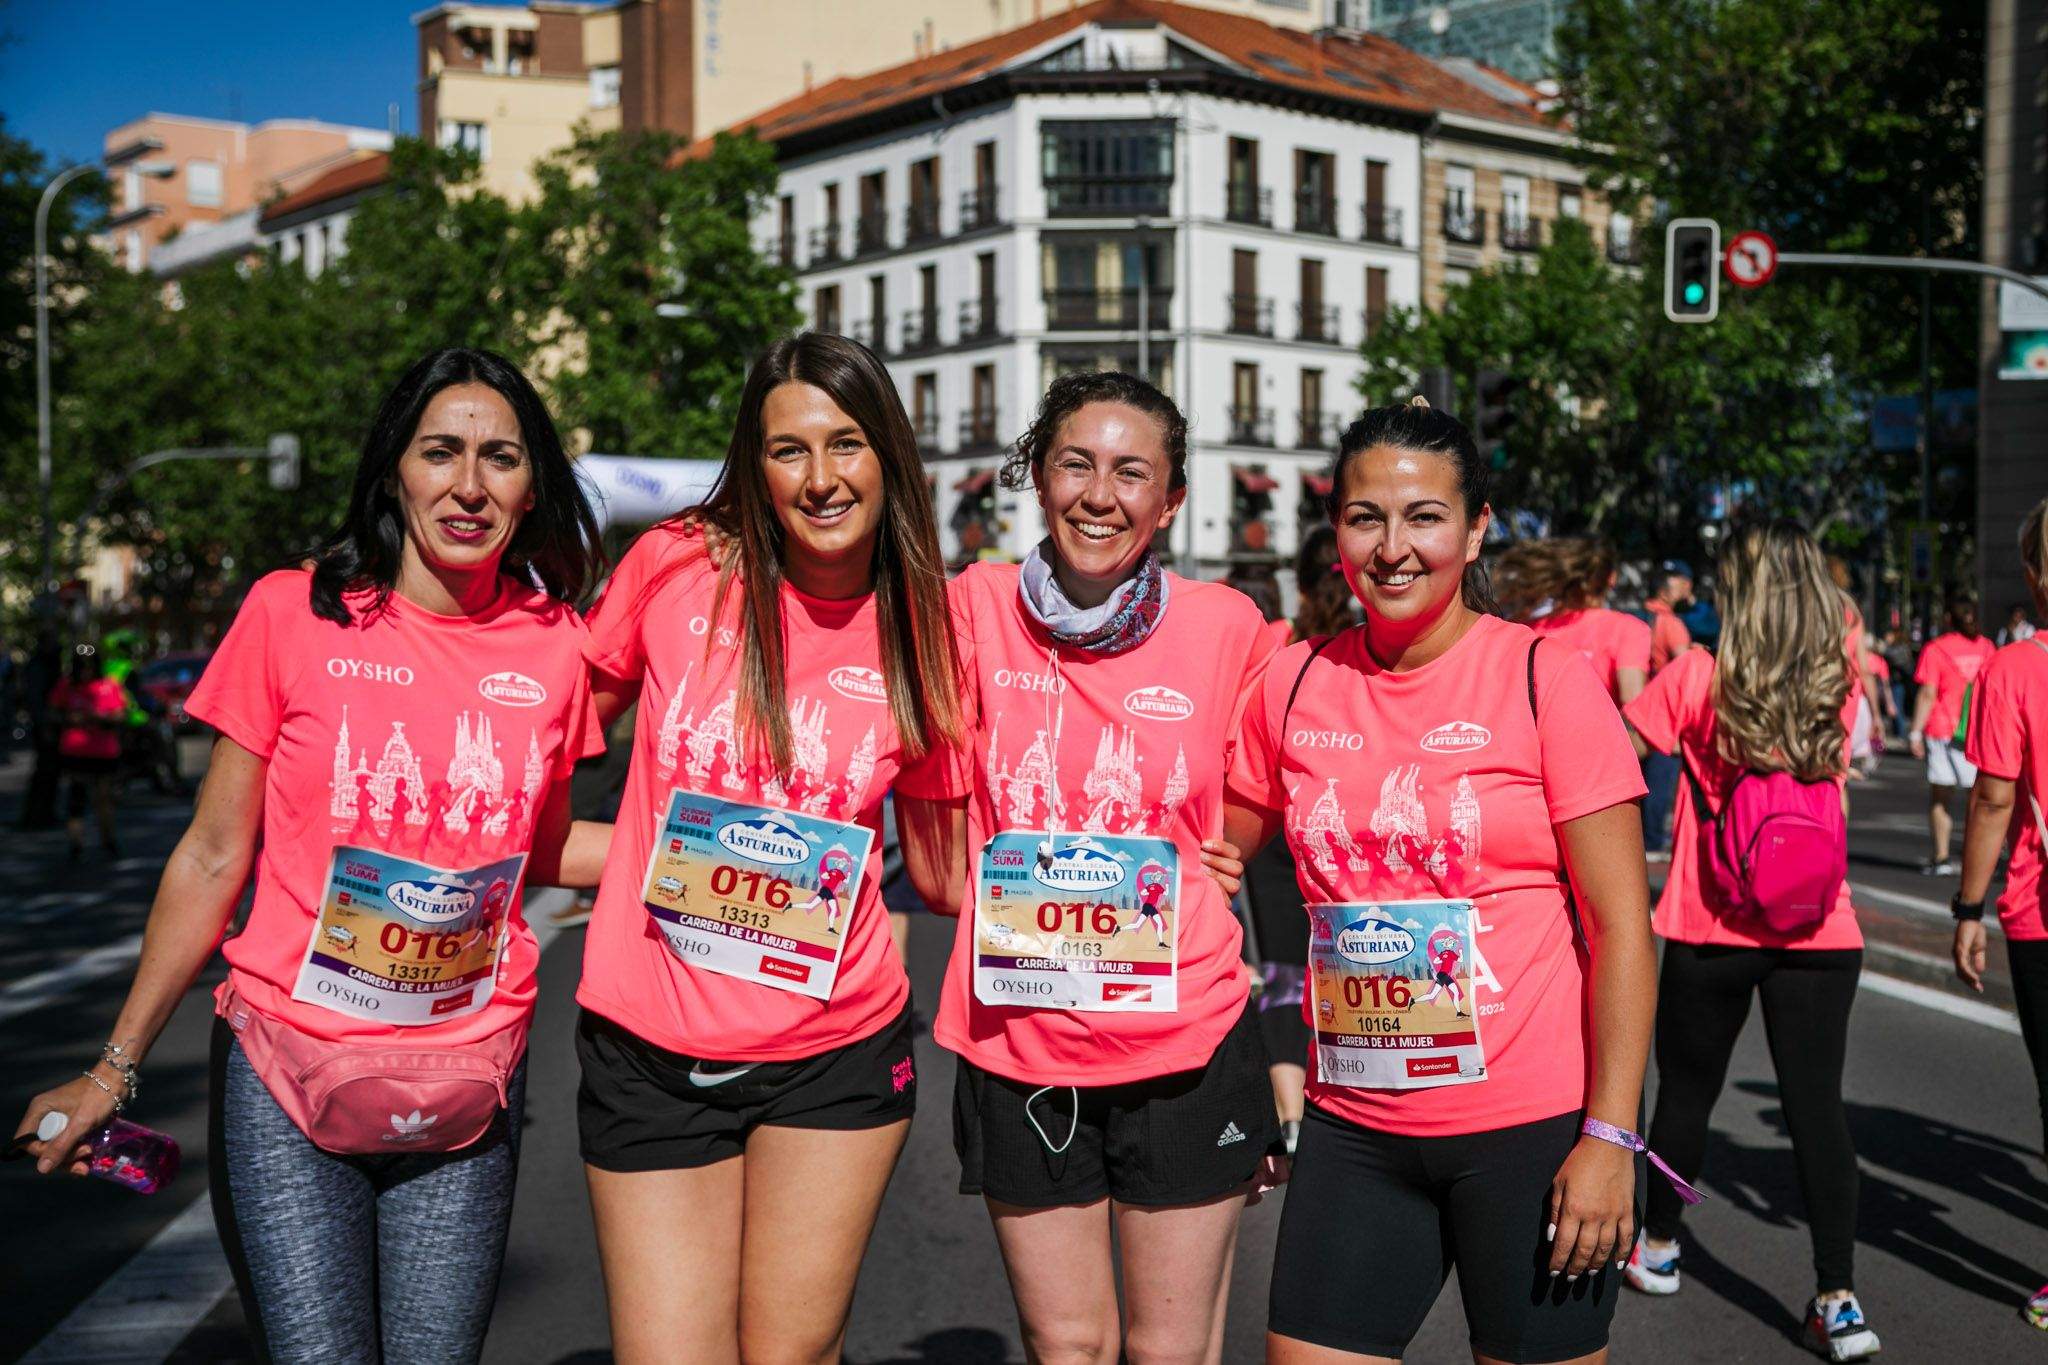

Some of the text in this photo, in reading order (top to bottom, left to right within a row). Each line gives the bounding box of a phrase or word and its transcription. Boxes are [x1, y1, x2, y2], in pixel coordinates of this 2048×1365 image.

[327, 658, 414, 686] OYSHO
[484, 682, 541, 701] ASTURIANA
[832, 673, 888, 698] ASTURIAN
[993, 669, 1066, 695] OYSHO
[1131, 695, 1189, 715] ASTURIANA
[1293, 730, 1364, 750] OYSHO
[1425, 735, 1485, 747] ASTURIANA
[679, 813, 711, 827] SUMA
[723, 828, 803, 860] ASTURIANA
[992, 857, 1024, 866] SUMA
[345, 865, 379, 882] SUMA
[1040, 868, 1118, 882] ASTURIANA
[710, 865, 793, 909] 016
[393, 886, 470, 914] ASTURIANA
[720, 905, 770, 929] 13313
[1037, 901, 1118, 935] 016
[379, 922, 462, 960] 016
[680, 914, 798, 952] CARRERA DE LA MUJER
[666, 932, 711, 956] YSHO
[1341, 935, 1410, 954] ASTURIANA
[388, 963, 443, 980] 13317
[774, 964, 804, 977] Santander
[1016, 957, 1133, 973] CARRERA DE LA MUJER
[348, 965, 397, 992] CARRERA
[400, 982, 414, 993] DE
[416, 982, 430, 993] LA
[993, 979, 1053, 995] OYSHO
[317, 979, 381, 1011] OYSHO
[1343, 975, 1412, 1008] 016
[1479, 1002, 1505, 1016] 2022
[1357, 1017, 1402, 1032] 10164
[1337, 1035, 1434, 1048] CARRERA DE LA MUJER
[1327, 1056, 1365, 1075] OYSHO
[1420, 1061, 1453, 1072] Santander
[1217, 1133, 1246, 1147] adidas
